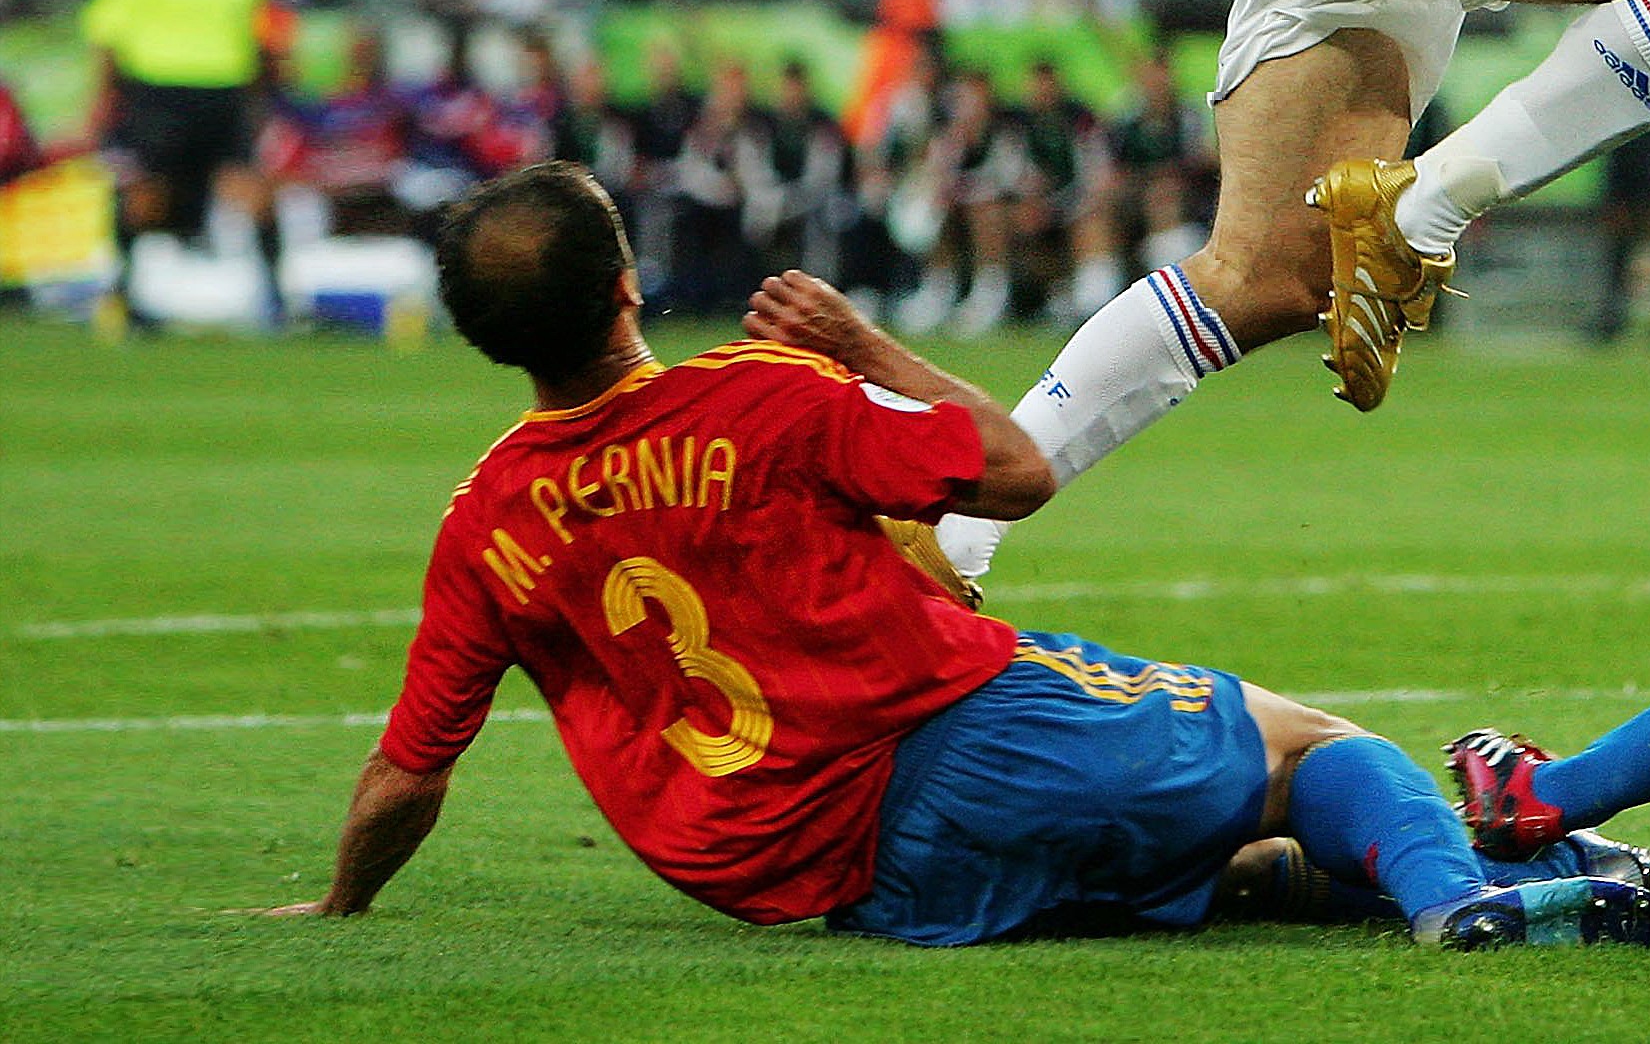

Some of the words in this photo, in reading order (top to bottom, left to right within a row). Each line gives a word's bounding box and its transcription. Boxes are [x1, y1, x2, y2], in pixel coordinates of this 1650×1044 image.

[483, 528, 552, 606] M.
[529, 436, 737, 545] PERNIA
[603, 556, 774, 778] 3
